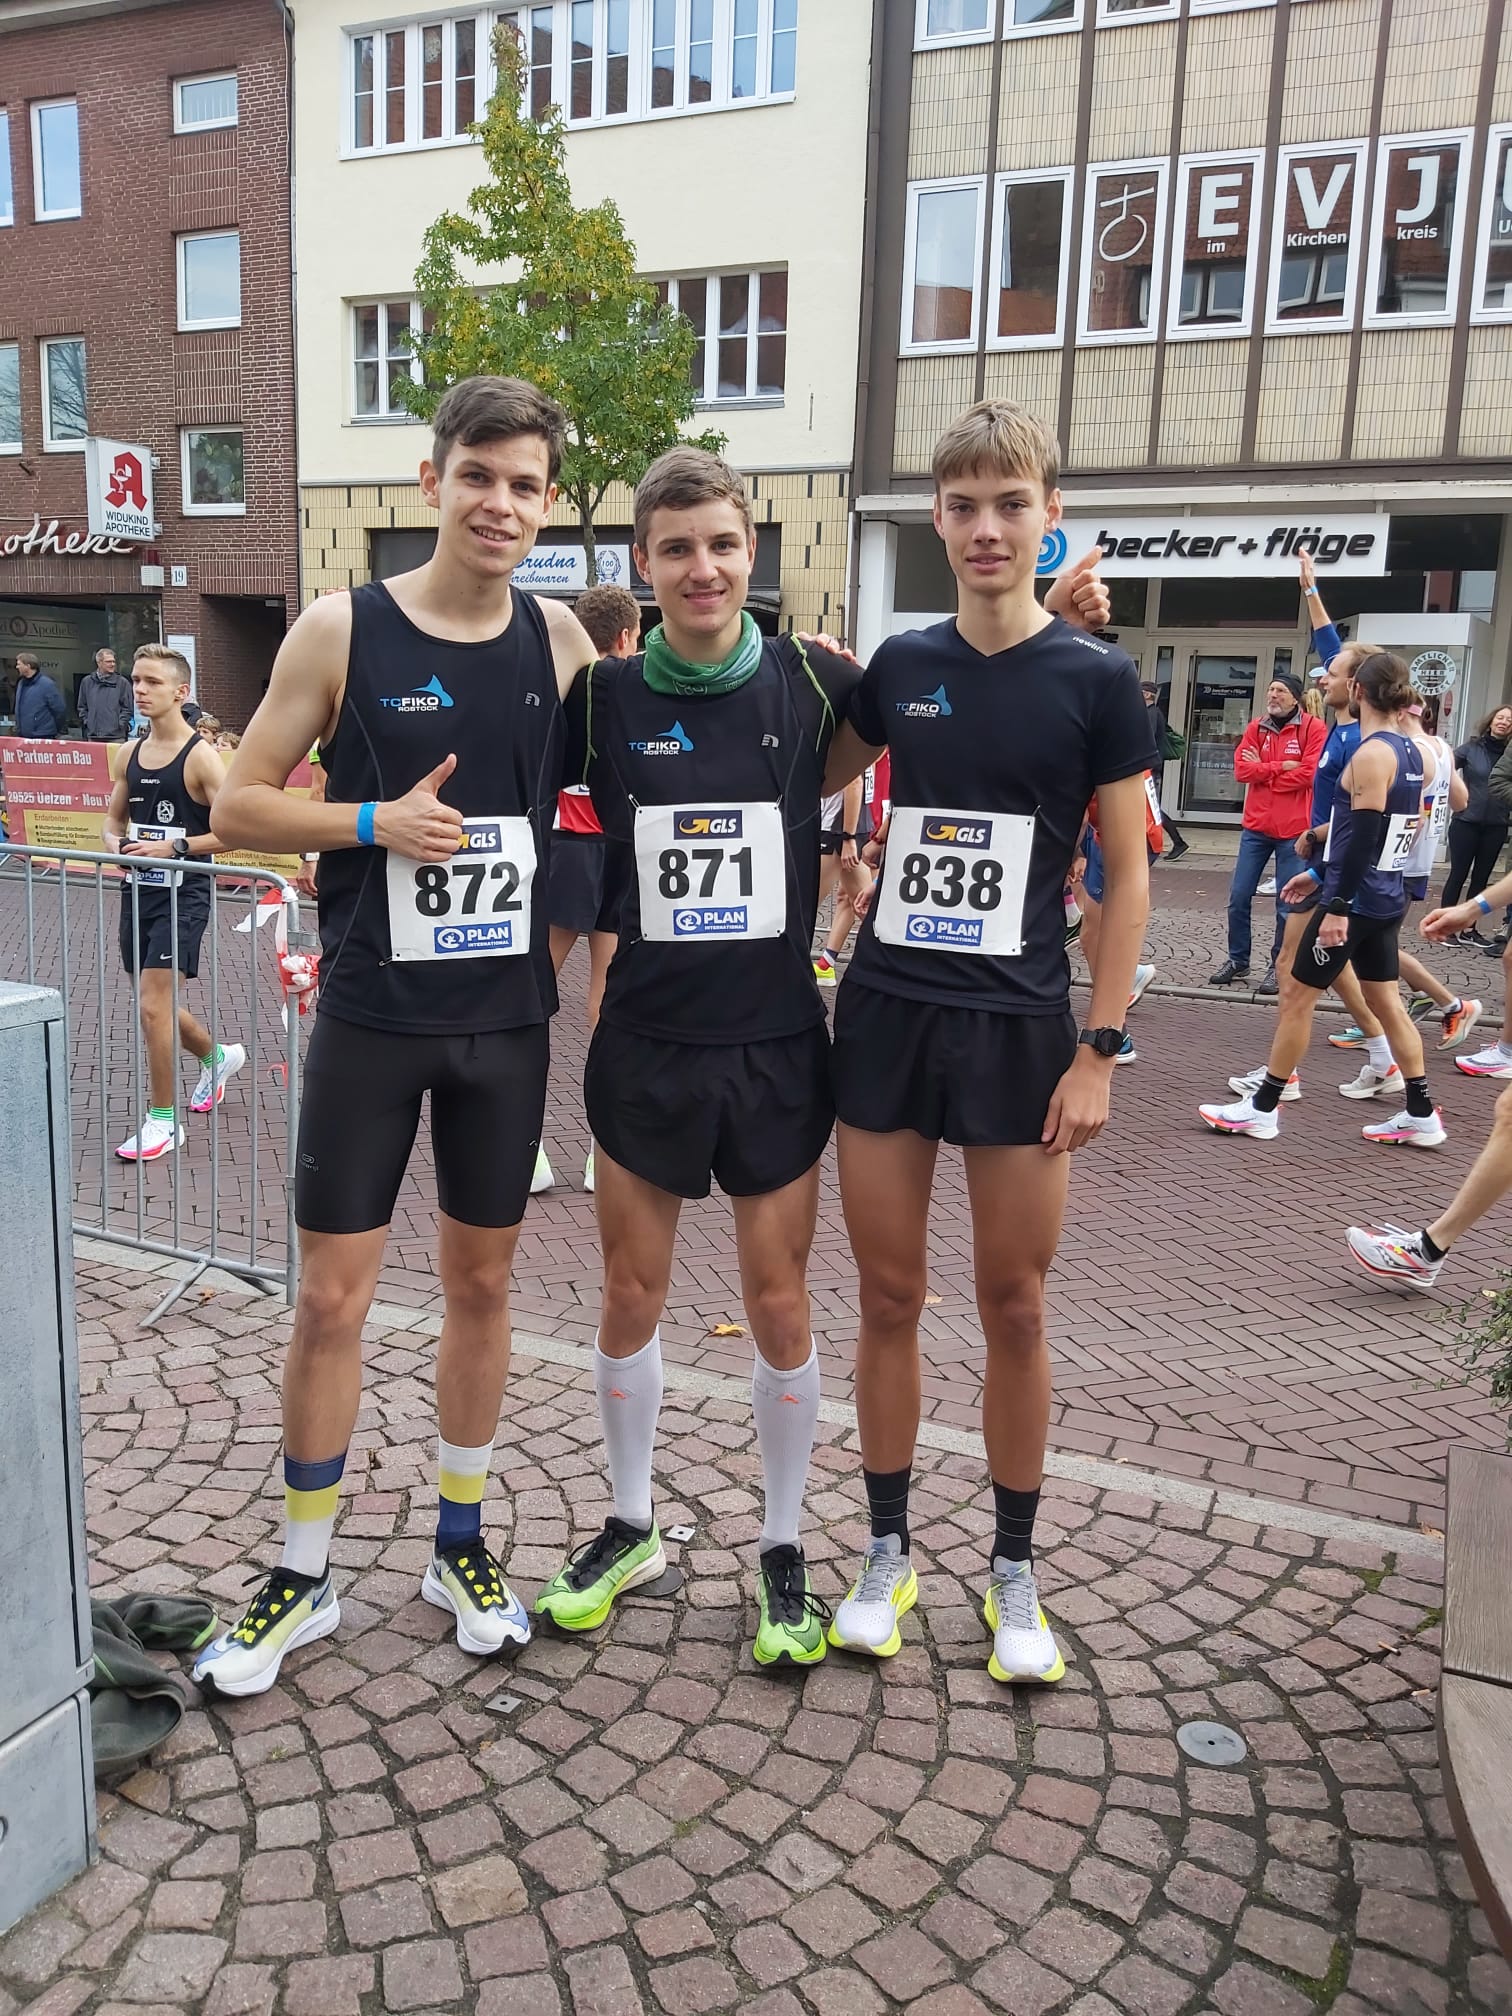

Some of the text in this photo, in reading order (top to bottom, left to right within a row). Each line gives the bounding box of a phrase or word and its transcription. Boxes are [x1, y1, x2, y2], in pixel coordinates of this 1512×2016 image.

[1197, 172, 1243, 238] E
[1293, 163, 1352, 229] V
[1395, 155, 1440, 224] J
[1206, 239, 1226, 254] im
[1286, 231, 1348, 248] Kirchen
[1396, 225, 1438, 241] kreis
[105, 510, 149, 526] WIDUKIND
[105, 522, 151, 537] APOTHEKE
[1095, 529, 1237, 559] becker
[1263, 527, 1376, 564] flöge
[174, 570, 184, 583] 19
[1071, 635, 1110, 655] newline
[1411, 652, 1455, 673] AMTLICHER
[397, 705, 439, 713] ROSTOCK
[904, 710, 937, 719] ROSTOCK
[3, 748, 92, 766] Ihr Partner am Bau
[37, 791, 72, 805] Uelzen
[82, 793, 103, 807] Neu
[709, 817, 737, 834] GLS
[149, 831, 164, 840] GLS
[470, 832, 497, 849] GLS
[956, 826, 987, 844] GLS
[658, 846, 753, 900] 871
[414, 860, 523, 918] 872
[898, 852, 1004, 912] 838
[703, 911, 745, 924] PLAN
[467, 926, 509, 941] PLAN
[704, 923, 745, 931] INTERNATIONAL
[937, 921, 980, 937] PLAN
[467, 939, 510, 948] INTERNATIONAL
[936, 935, 979, 944] INTERNATIONAL
